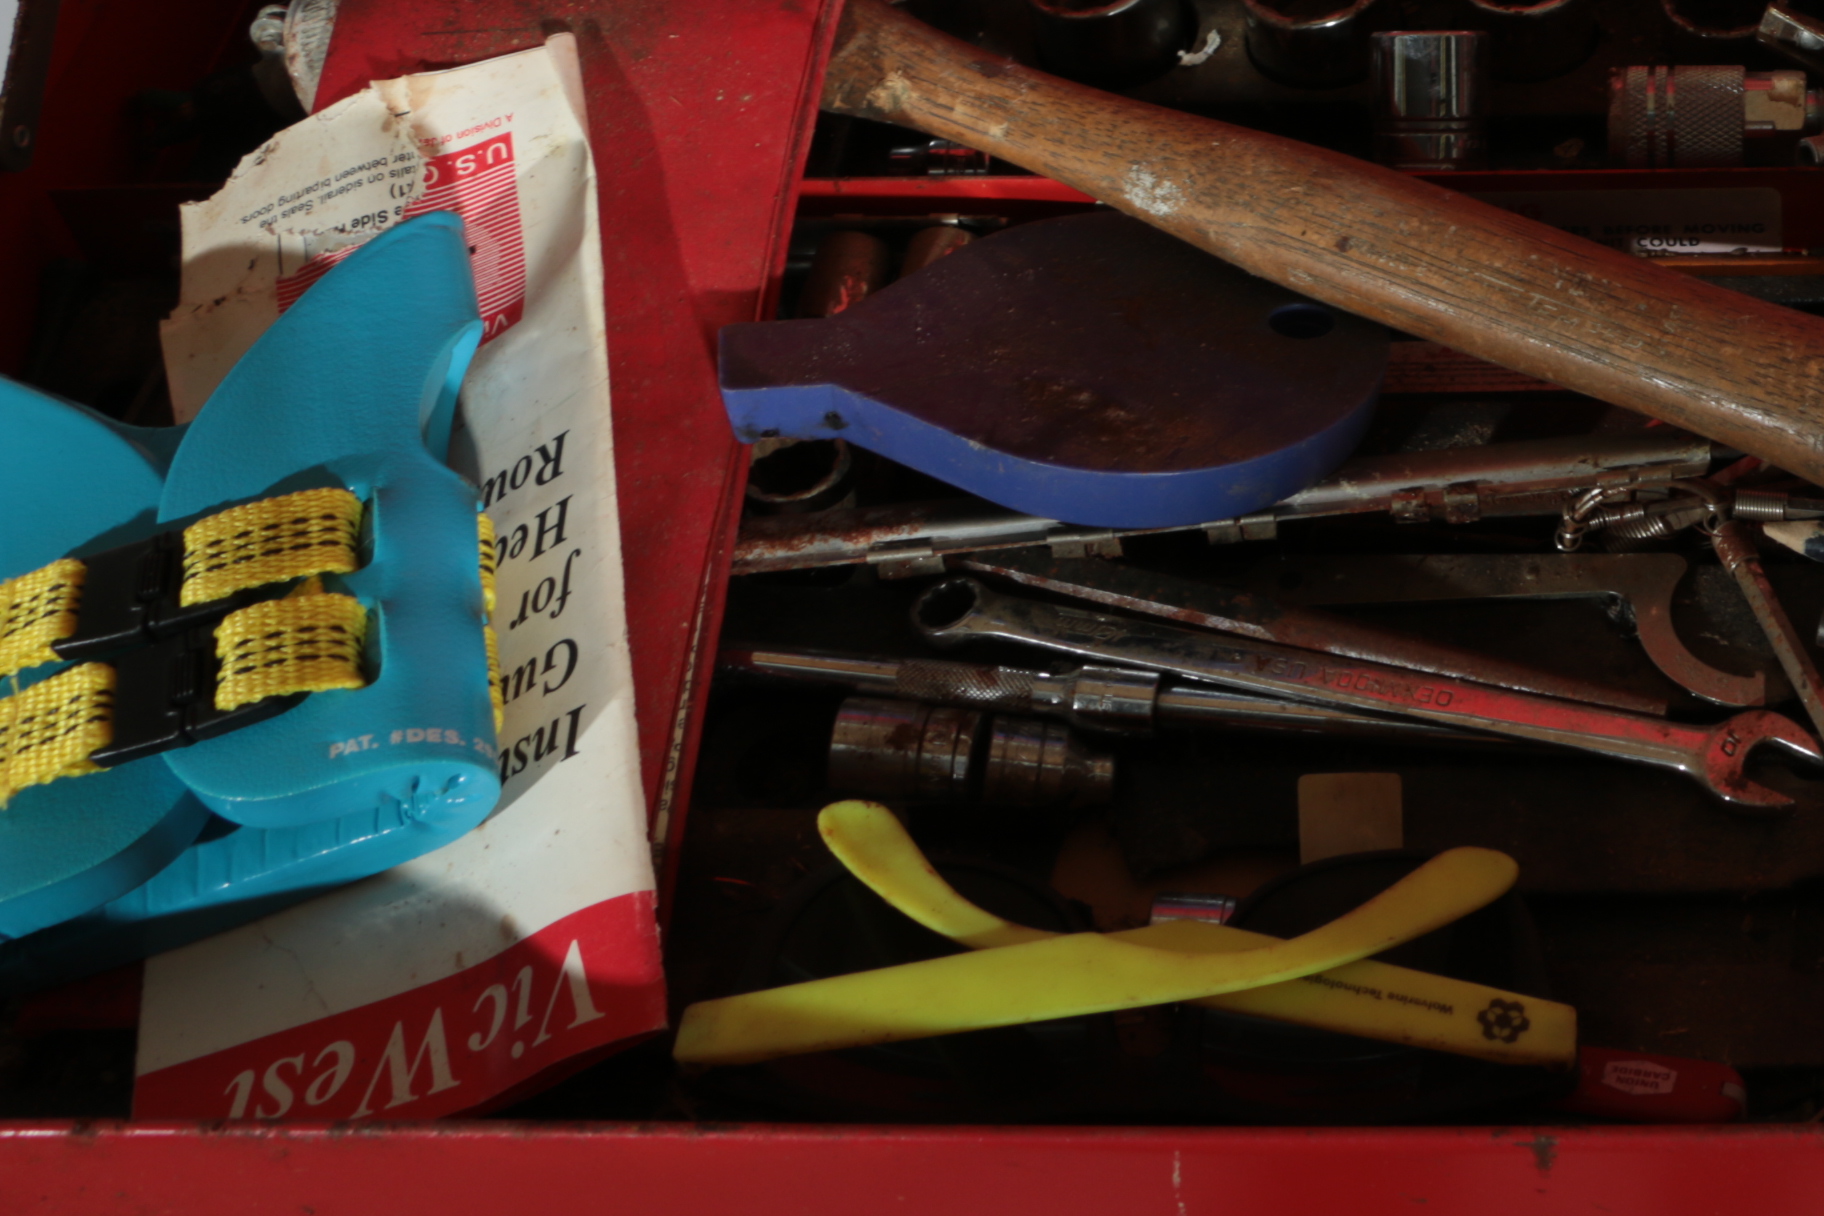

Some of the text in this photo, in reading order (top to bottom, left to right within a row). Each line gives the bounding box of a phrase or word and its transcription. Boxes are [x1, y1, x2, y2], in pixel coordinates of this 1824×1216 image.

[457, 116, 503, 139] Division
[334, 156, 388, 182] between
[367, 171, 386, 184] on
[277, 177, 332, 207] biparting
[320, 178, 363, 207] siderail.
[240, 202, 275, 225] doors.
[281, 199, 314, 220] Seals
[350, 208, 389, 231] Side
[258, 213, 279, 230] the
[1603, 223, 1673, 236] BEFORE
[1683, 221, 1765, 235] MOVING
[1636, 236, 1701, 248] COULD
[481, 429, 571, 509] Rou
[509, 548, 581, 630] for
[1253, 654, 1308, 681] USA
[328, 733, 380, 760] PAT.
[1387, 991, 1454, 1015] Wolverine
[222, 938, 607, 1120] VicWest
[1612, 1066, 1671, 1081] CARBIDE
[1615, 1075, 1660, 1089] UNION
